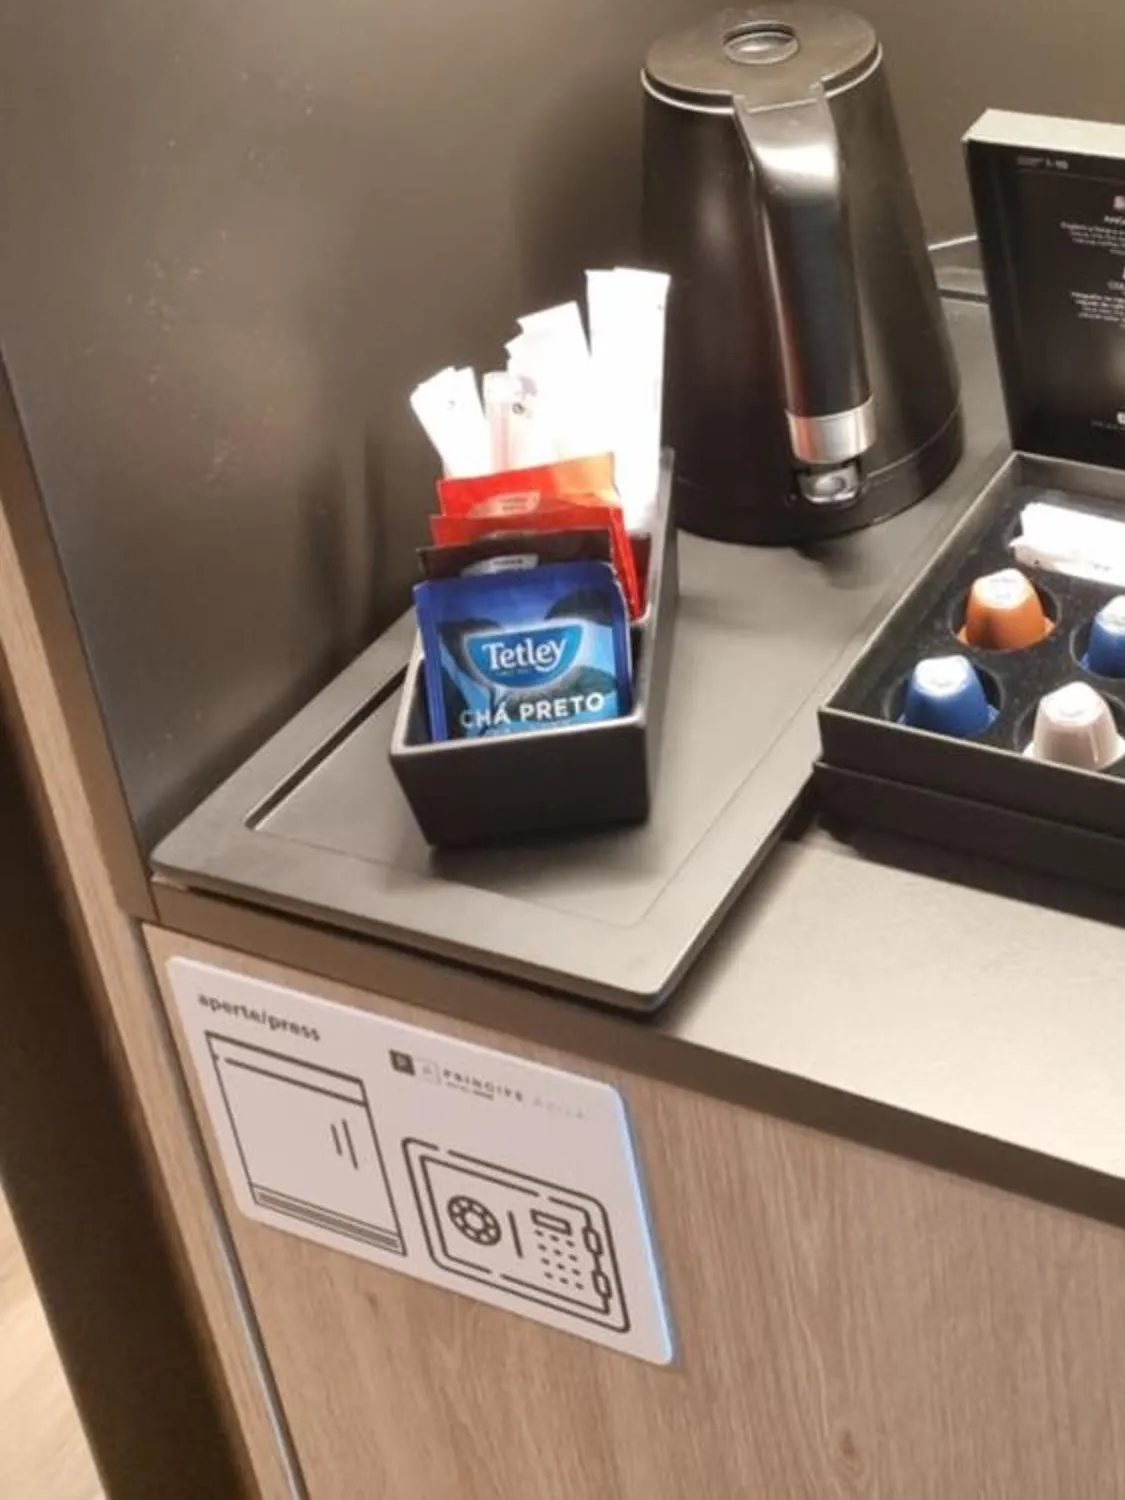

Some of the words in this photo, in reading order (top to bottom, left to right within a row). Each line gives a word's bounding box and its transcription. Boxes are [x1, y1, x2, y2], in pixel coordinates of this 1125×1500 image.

[481, 637, 567, 672] Tetley
[460, 702, 511, 728] CHÁ
[519, 691, 605, 722] PRETO
